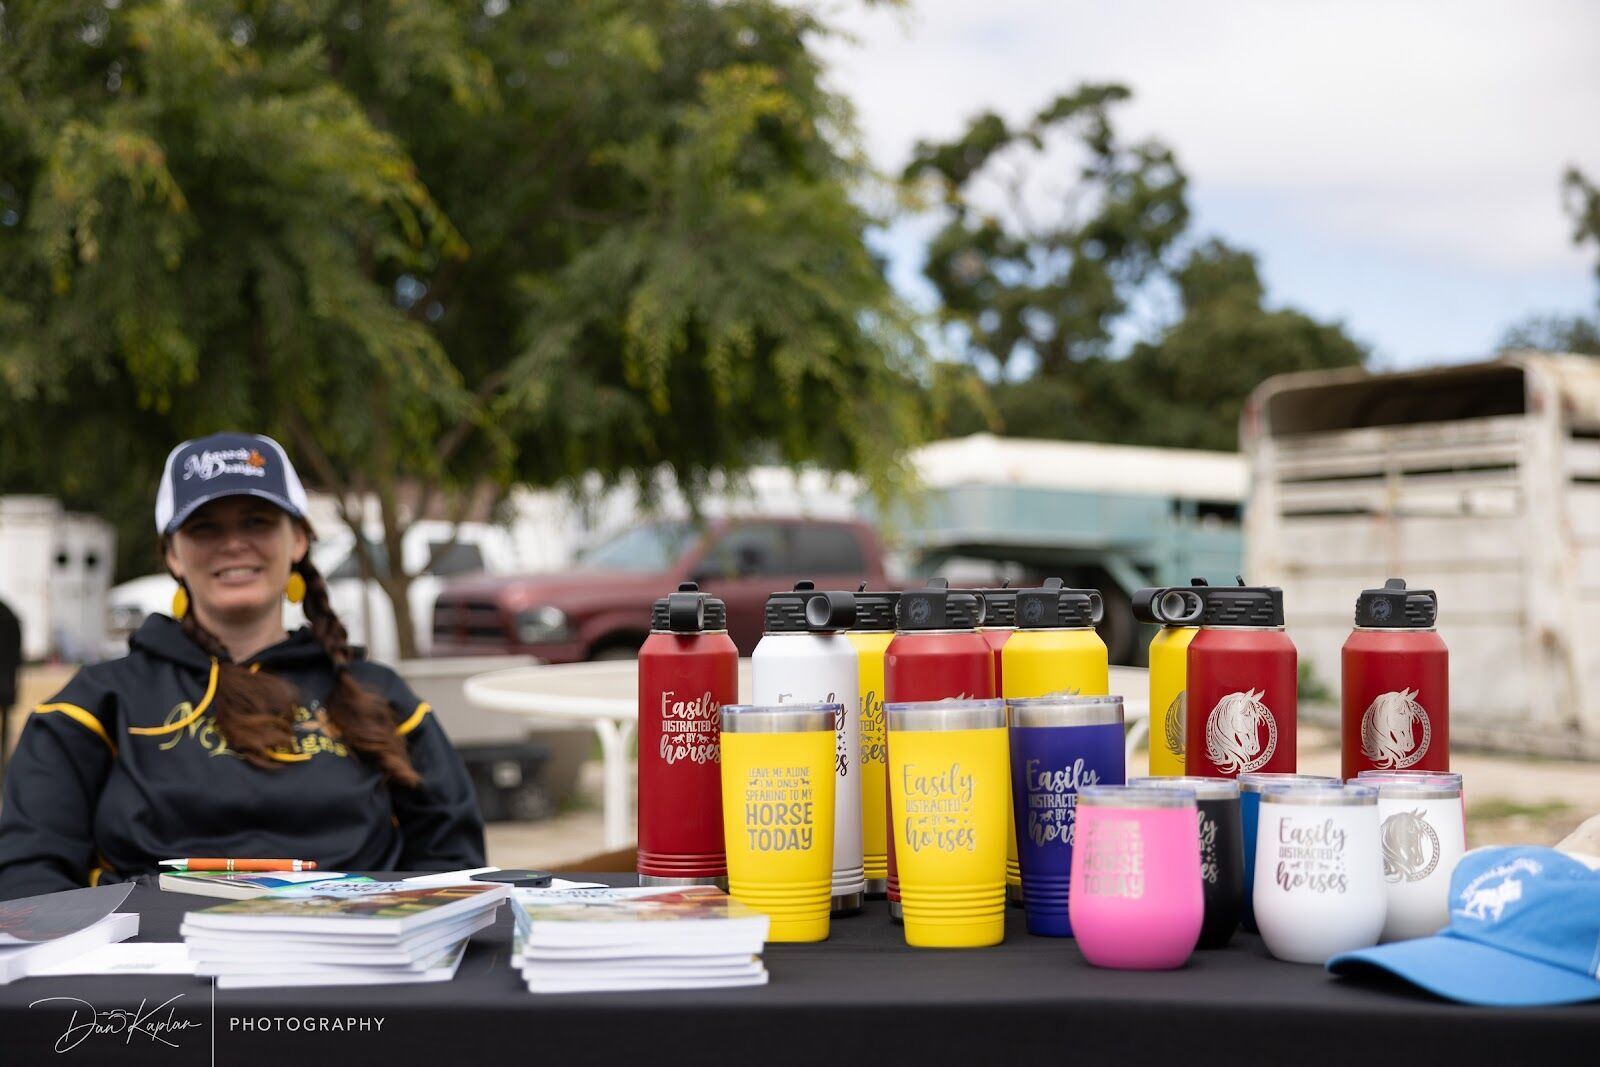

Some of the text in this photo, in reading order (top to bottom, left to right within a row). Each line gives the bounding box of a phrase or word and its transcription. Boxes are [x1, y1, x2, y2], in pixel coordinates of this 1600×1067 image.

[661, 691, 720, 725] Easily
[662, 720, 711, 732] DISTRACTED
[660, 734, 720, 765] horses
[686, 733, 697, 743] BY
[749, 767, 810, 777] LEAVE ME ALONE
[777, 779, 799, 788] ONLY
[903, 762, 974, 803] Easily
[1026, 758, 1100, 793] Easily
[745, 790, 813, 801] SPEAKING TO MY
[905, 799, 960, 813] DISTRACTED
[1028, 793, 1077, 808] DISTRACTE
[745, 802, 813, 826] HORSE
[1055, 809, 1067, 821] BY
[747, 828, 813, 851] TODAY
[905, 816, 976, 852] horses
[1028, 810, 1076, 847] hors
[1279, 816, 1348, 853] Easily
[1279, 847, 1332, 859] DISTRACTED
[1276, 861, 1348, 893] horses
